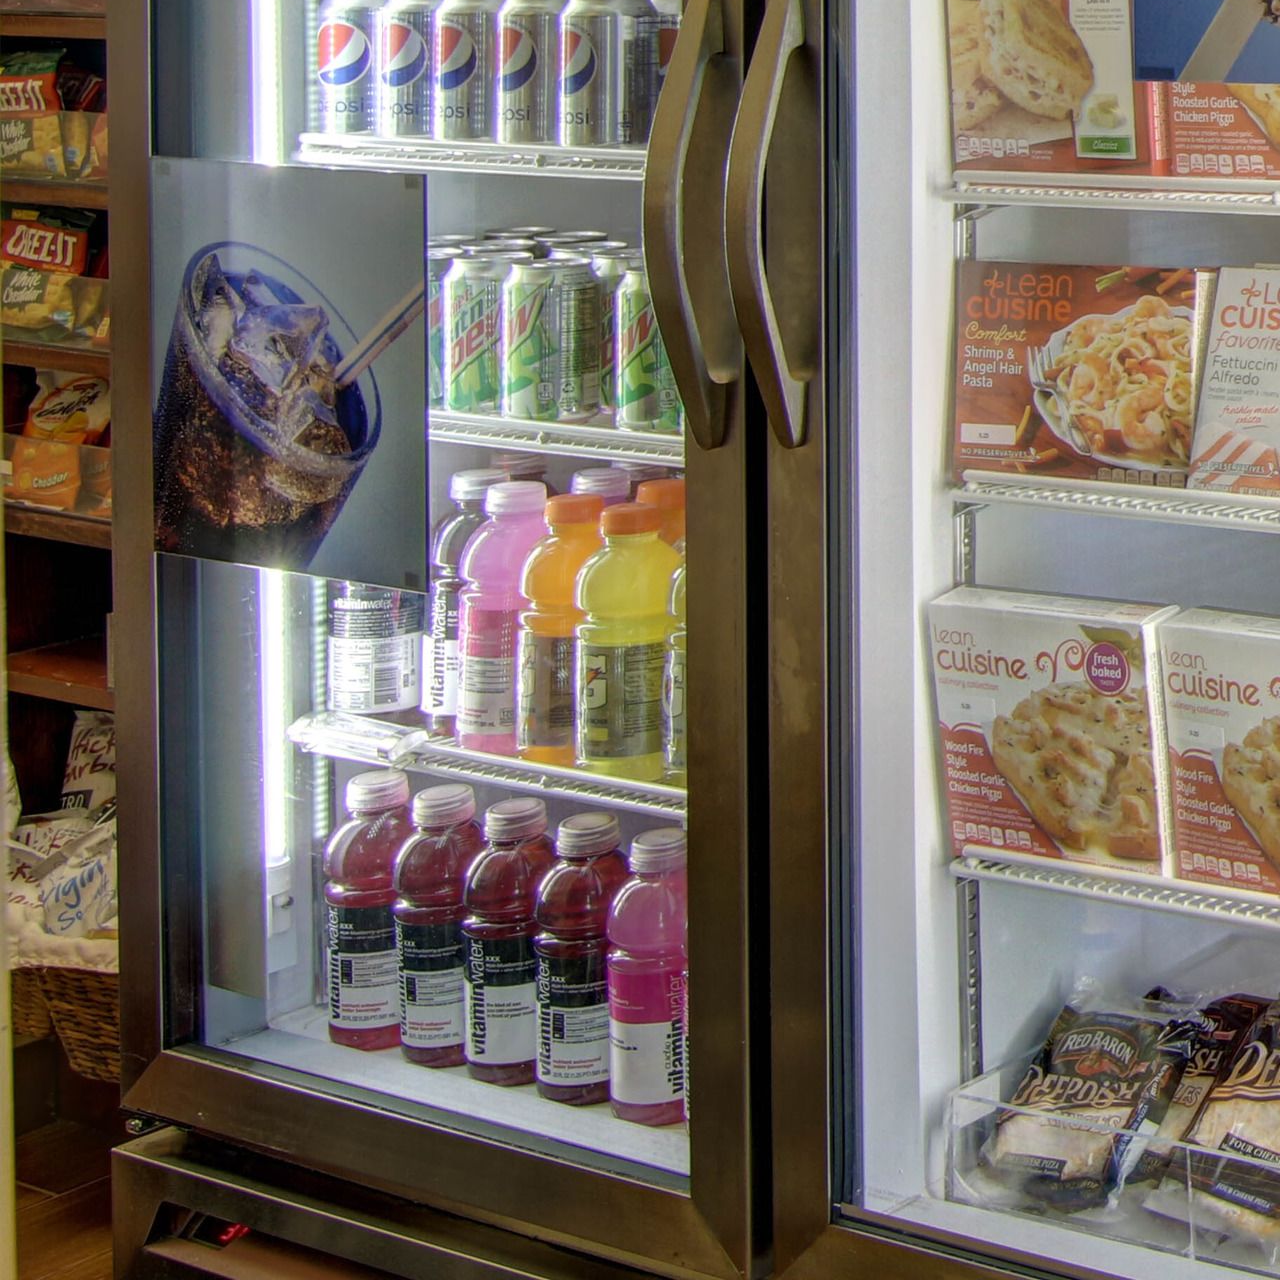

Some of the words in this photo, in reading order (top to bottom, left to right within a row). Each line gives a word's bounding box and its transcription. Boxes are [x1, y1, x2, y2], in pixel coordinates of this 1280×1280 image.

[1172, 82, 1196, 96] Style
[1173, 96, 1208, 109] Roasted
[1210, 97, 1239, 110] Garlic
[1174, 110, 1209, 123] Chicken
[6, 224, 77, 267] CHEEZ-IT
[10, 268, 42, 289] White
[1006, 273, 1073, 297] Lean
[3, 286, 43, 304] Cheddar
[964, 320, 1027, 346] Comfort
[964, 345, 1004, 360] Shrimp
[1006, 347, 1015, 359] &
[963, 360, 997, 375] Angel
[999, 361, 1024, 375] Hair
[1212, 354, 1279, 373] Fettuccini
[962, 374, 993, 388] Pasta
[1209, 370, 1260, 386] Alfredo
[961, 447, 972, 455] NO
[972, 448, 1028, 459] PRESERVATIVES
[32, 471, 69, 489] Cheddar
[933, 623, 976, 647] lean
[936, 647, 1030, 680] cuisine
[1093, 651, 1120, 667] fresh
[1164, 644, 1207, 670] lean
[1091, 666, 1122, 680] baked
[1168, 670, 1261, 706] cuisine
[944, 738, 967, 754] Wood
[966, 743, 985, 756] Fire
[946, 753, 968, 769] Style
[948, 767, 980, 783] Roasted
[980, 772, 1007, 787] Garlic
[1175, 764, 1198, 782] Wood
[1197, 770, 1215, 785] Fire
[949, 780, 980, 796] Chicken
[1175, 780, 1197, 796] Style
[1176, 795, 1208, 812] Roasted
[1209, 802, 1236, 817] Garlic
[1177, 808, 1208, 826] Chicken
[1061, 1032, 1091, 1051] RED
[1091, 1029, 1134, 1065] BARON
[1228, 1136, 1251, 1155] FOUR
